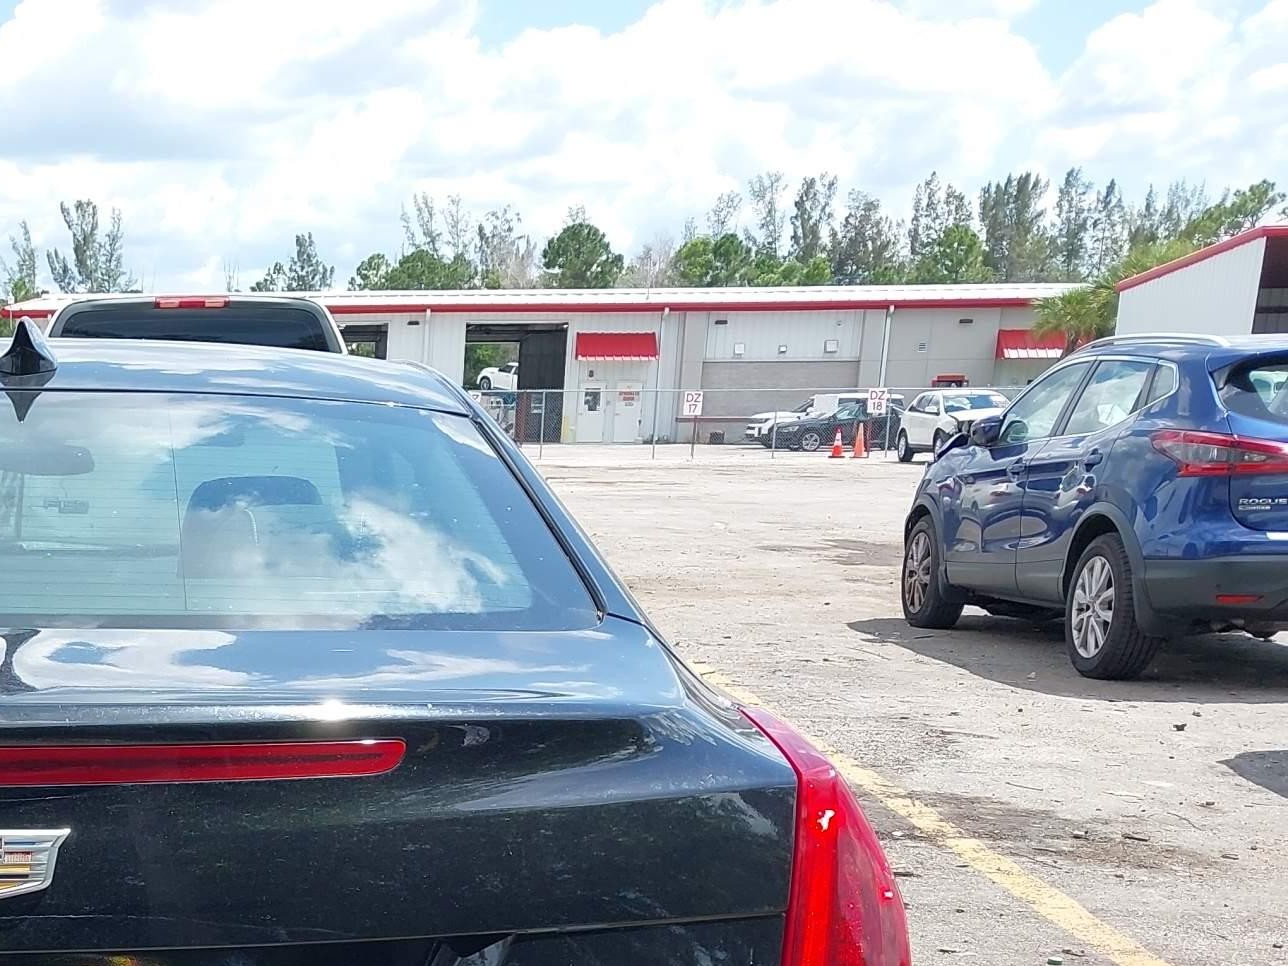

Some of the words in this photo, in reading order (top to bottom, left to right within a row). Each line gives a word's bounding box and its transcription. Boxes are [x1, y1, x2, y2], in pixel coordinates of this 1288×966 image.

[686, 392, 702, 402] DZ
[870, 390, 886, 400] DZ
[688, 403, 698, 413] 17
[872, 402, 883, 411] 18
